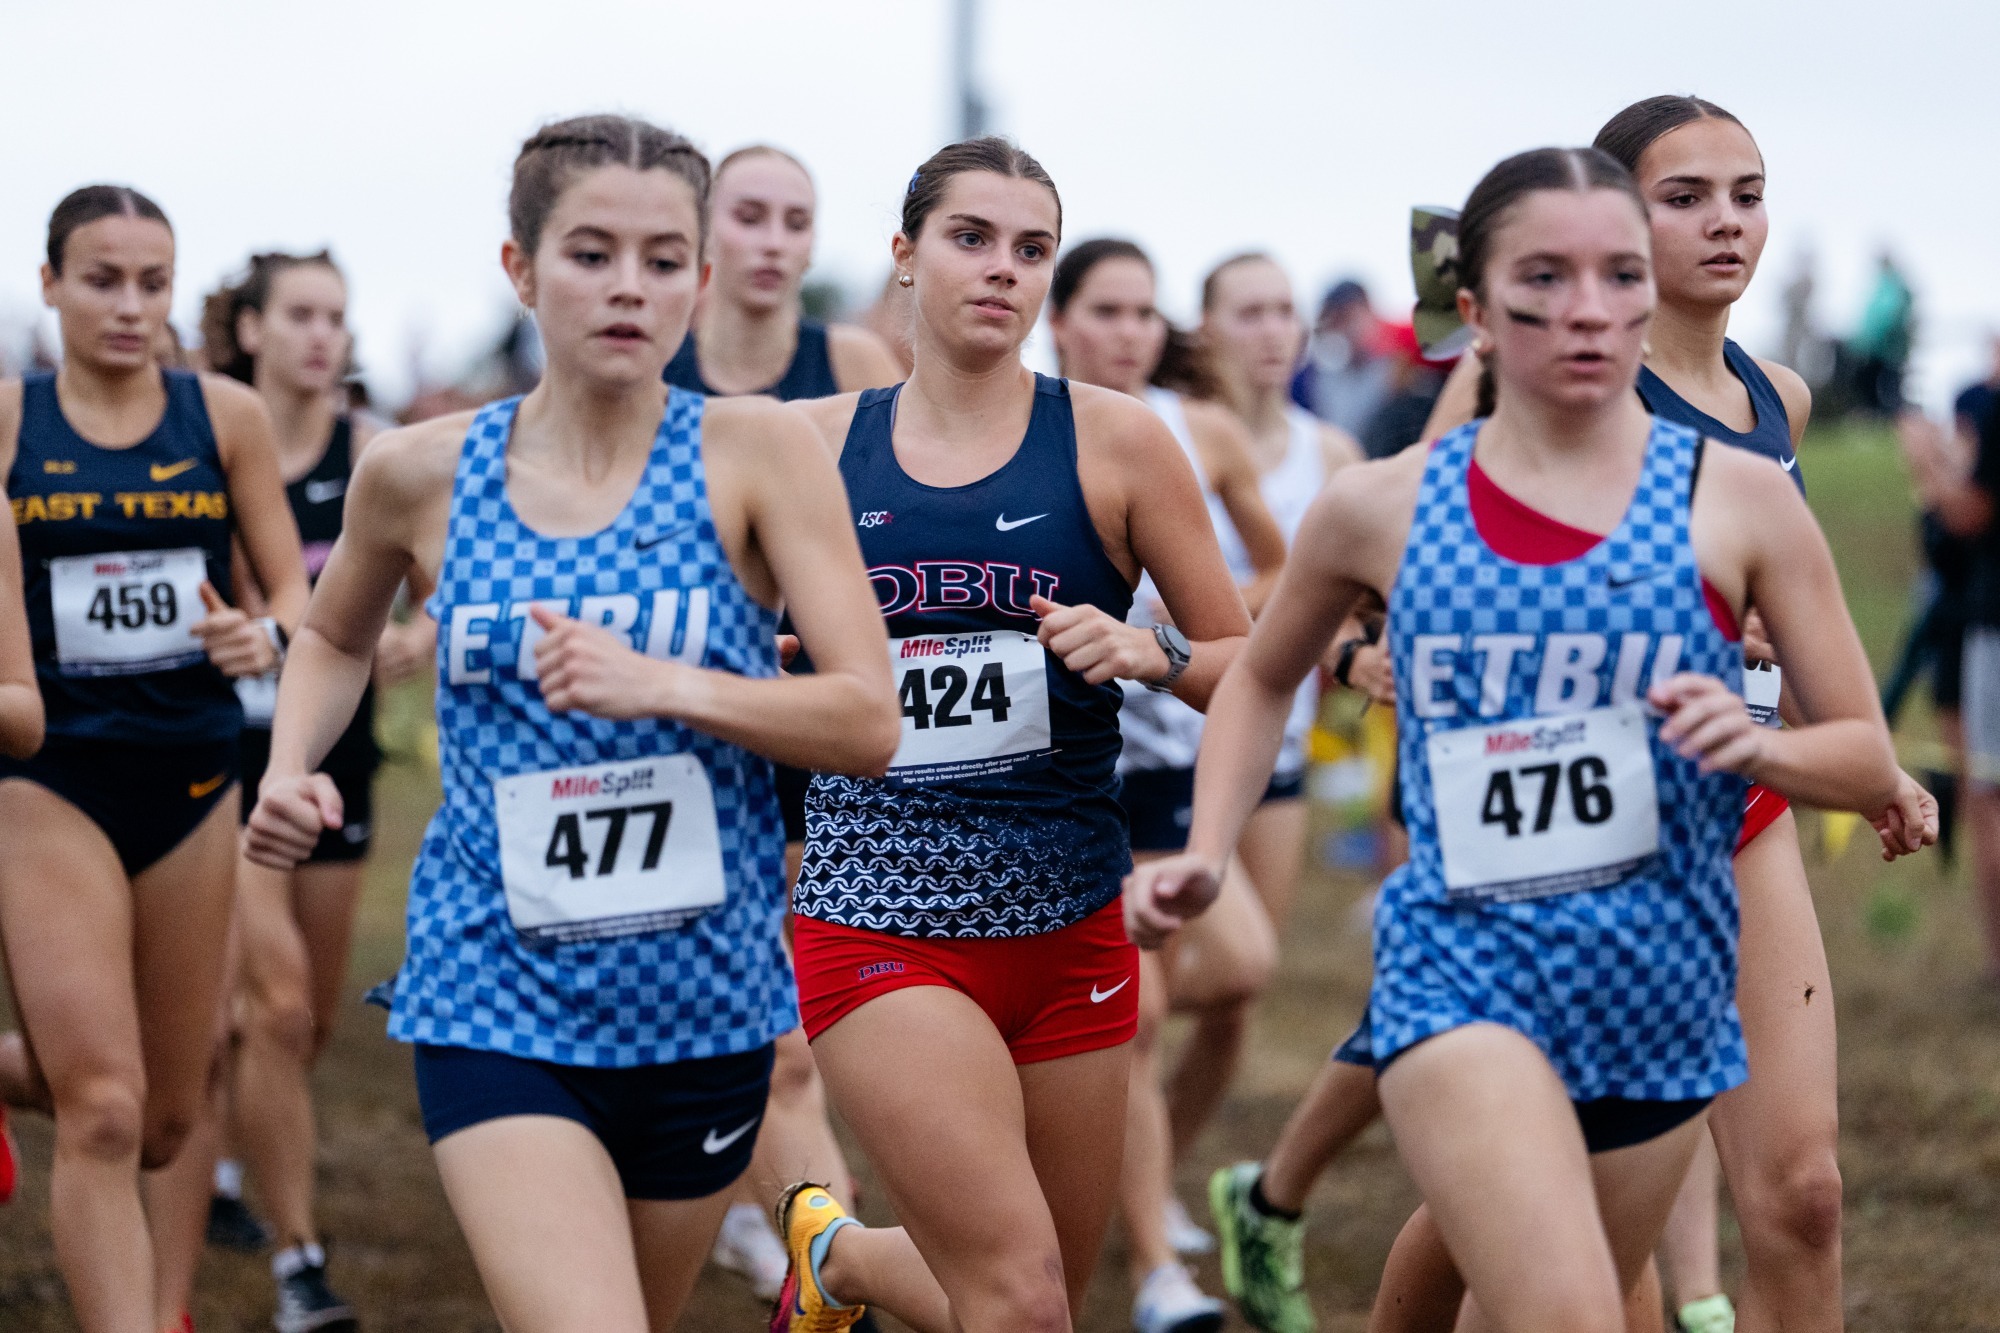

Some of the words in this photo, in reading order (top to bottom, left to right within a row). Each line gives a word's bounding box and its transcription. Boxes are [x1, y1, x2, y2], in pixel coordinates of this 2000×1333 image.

[10, 492, 102, 526] EAST
[114, 491, 227, 519] TEXAS
[858, 511, 888, 528] LSC
[87, 582, 178, 632] 459
[900, 634, 992, 659] MileSplit
[1412, 633, 1683, 718] ETBU
[899, 662, 1012, 730] 424
[901, 769, 914, 777] your
[914, 767, 935, 775] results
[936, 765, 960, 773] emailed
[961, 763, 984, 771] directly
[984, 760, 998, 768] after
[999, 758, 1013, 766] your
[1013, 755, 1030, 763] race?
[953, 771, 978, 779] account
[987, 765, 1013, 774] MileSplit
[551, 768, 654, 799] MileSplit
[1482, 755, 1614, 837] 476
[545, 801, 673, 879] 477
[858, 961, 904, 980] DBU
